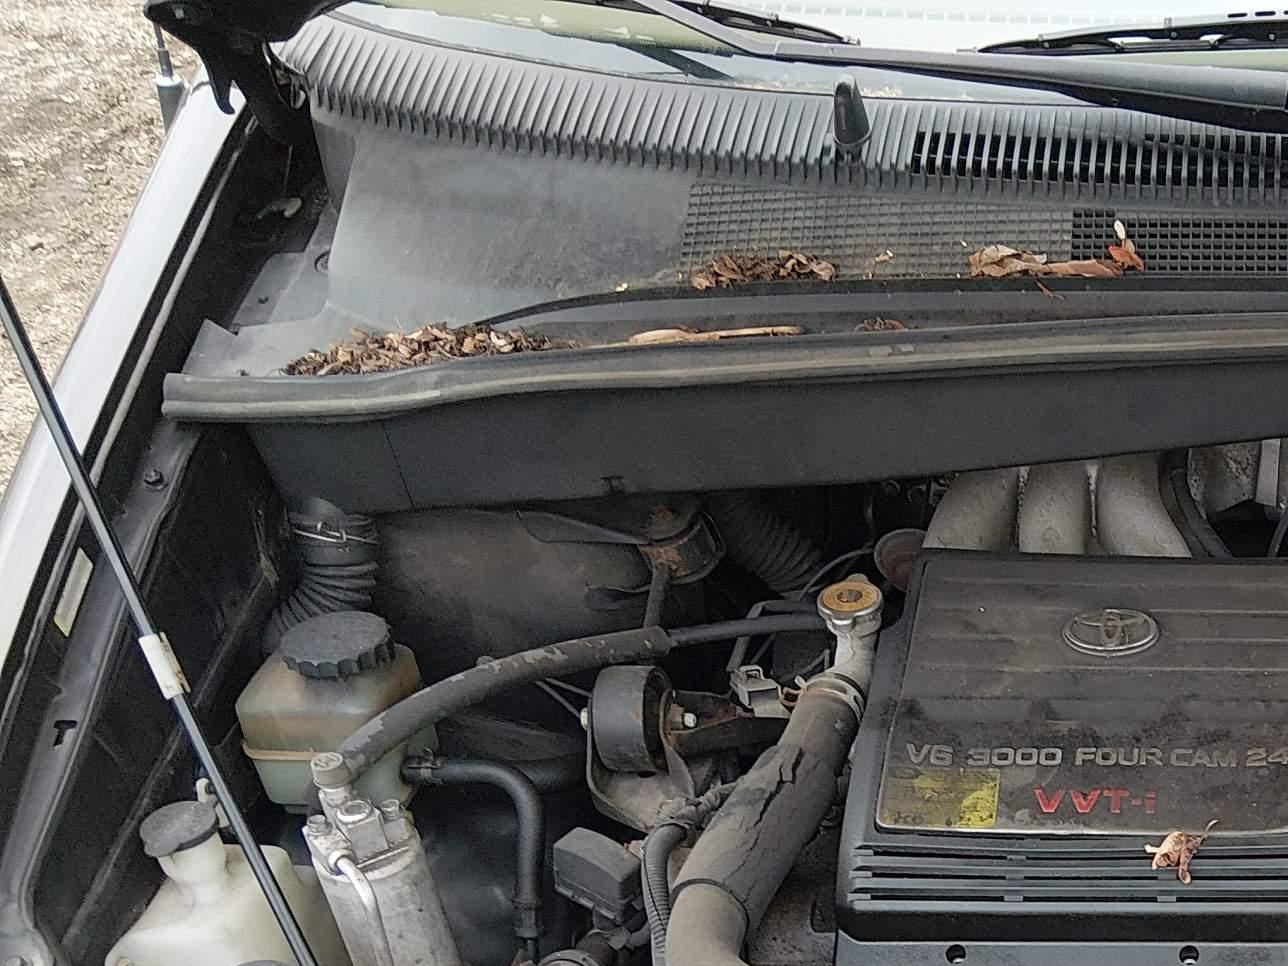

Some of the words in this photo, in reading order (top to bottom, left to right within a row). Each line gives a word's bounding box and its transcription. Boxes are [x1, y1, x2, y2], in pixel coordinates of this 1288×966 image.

[905, 743, 953, 766] V6
[967, 746, 1062, 766] 3000
[1075, 746, 1162, 766] FOUR
[1169, 748, 1237, 767] CAM
[1034, 786, 1158, 814] VVT-i
